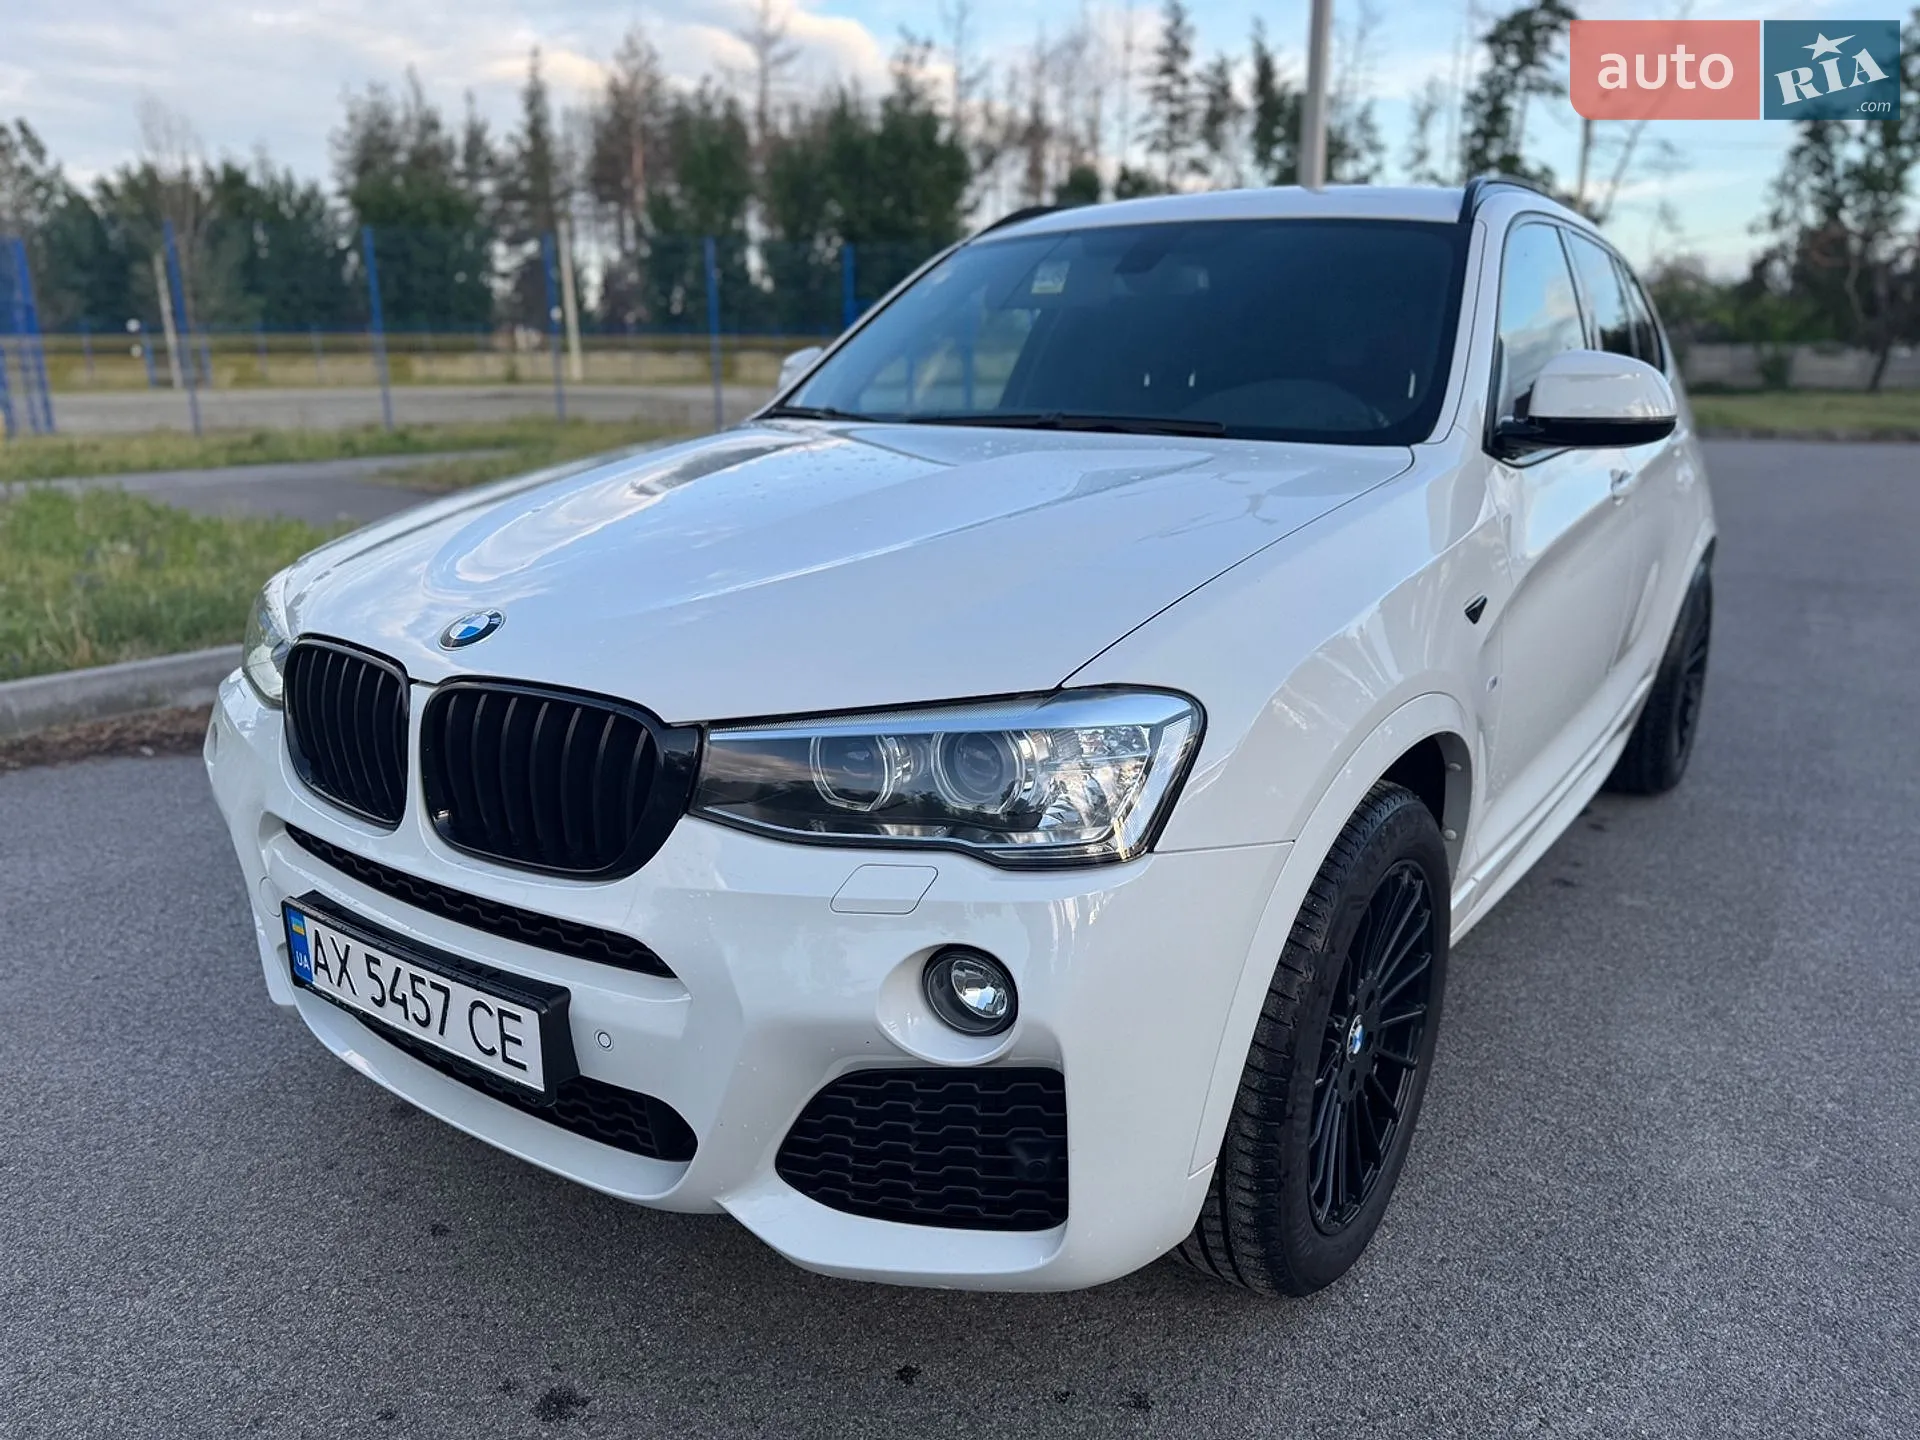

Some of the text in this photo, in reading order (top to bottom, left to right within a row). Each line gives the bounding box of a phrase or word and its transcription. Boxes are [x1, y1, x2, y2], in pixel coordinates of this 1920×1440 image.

[295, 950, 310, 970] UA
[314, 928, 527, 1071] AX 5457 CE
